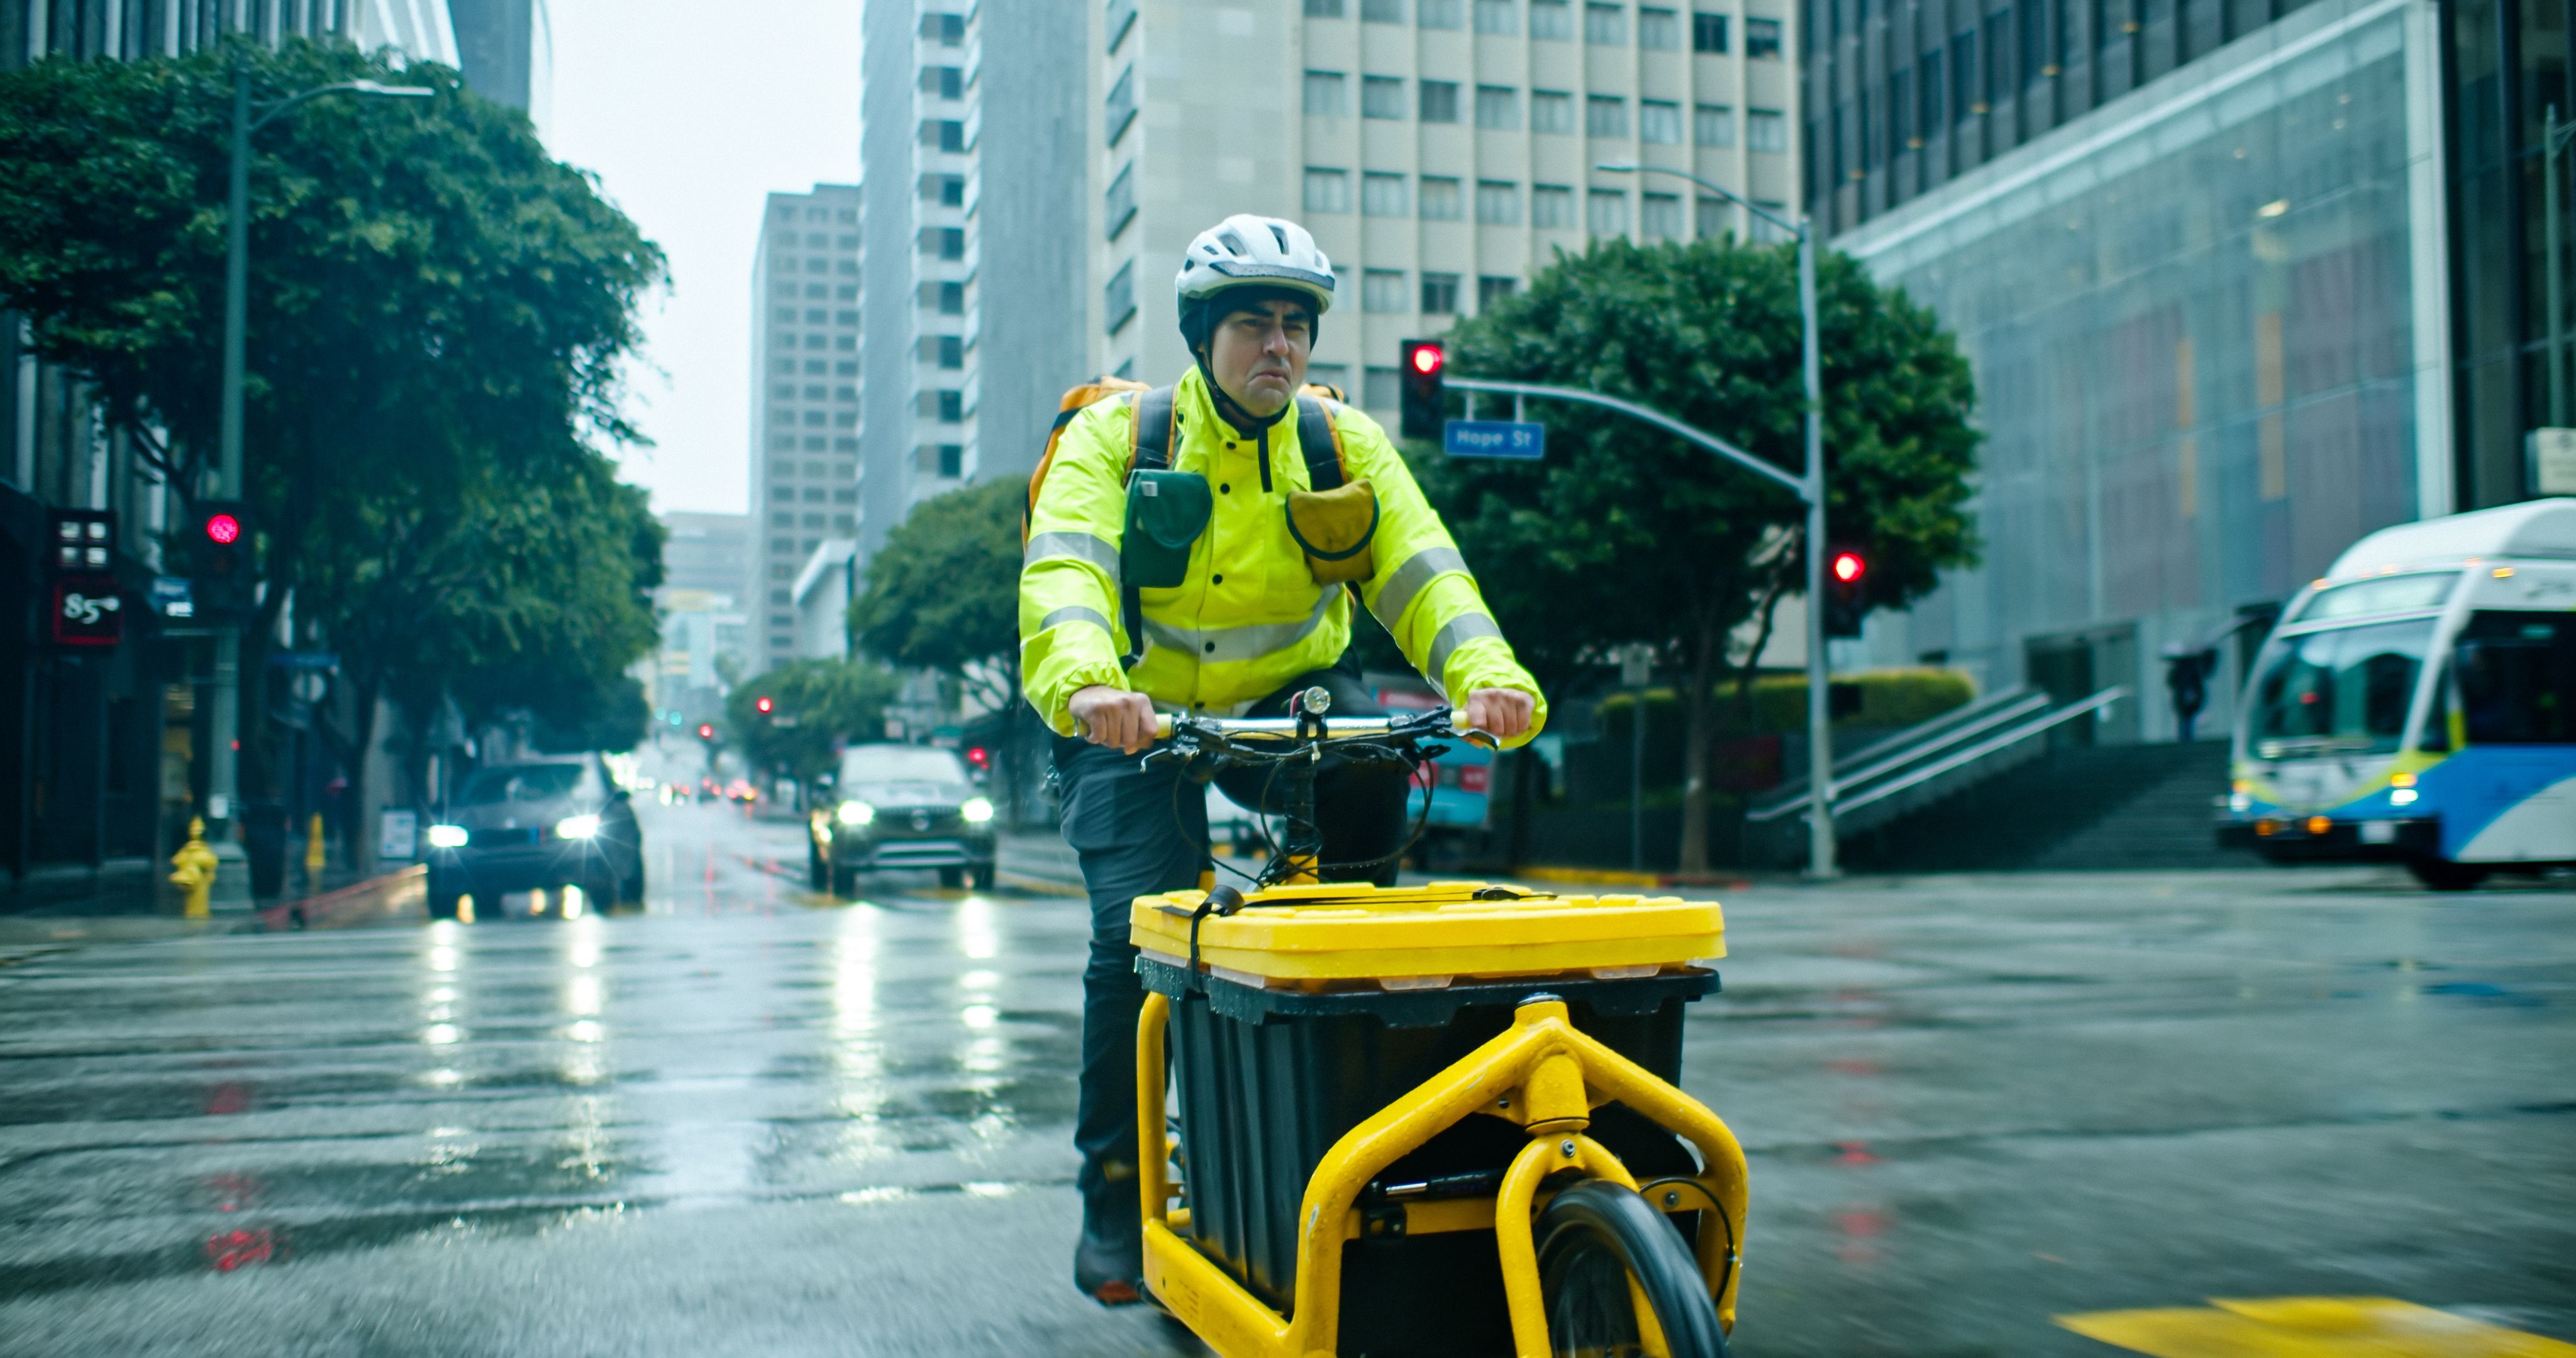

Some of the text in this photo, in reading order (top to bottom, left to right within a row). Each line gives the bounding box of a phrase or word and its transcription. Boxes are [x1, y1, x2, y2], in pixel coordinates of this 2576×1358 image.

[1457, 429, 1531, 447] Hope St
[64, 593, 120, 624] 85°
